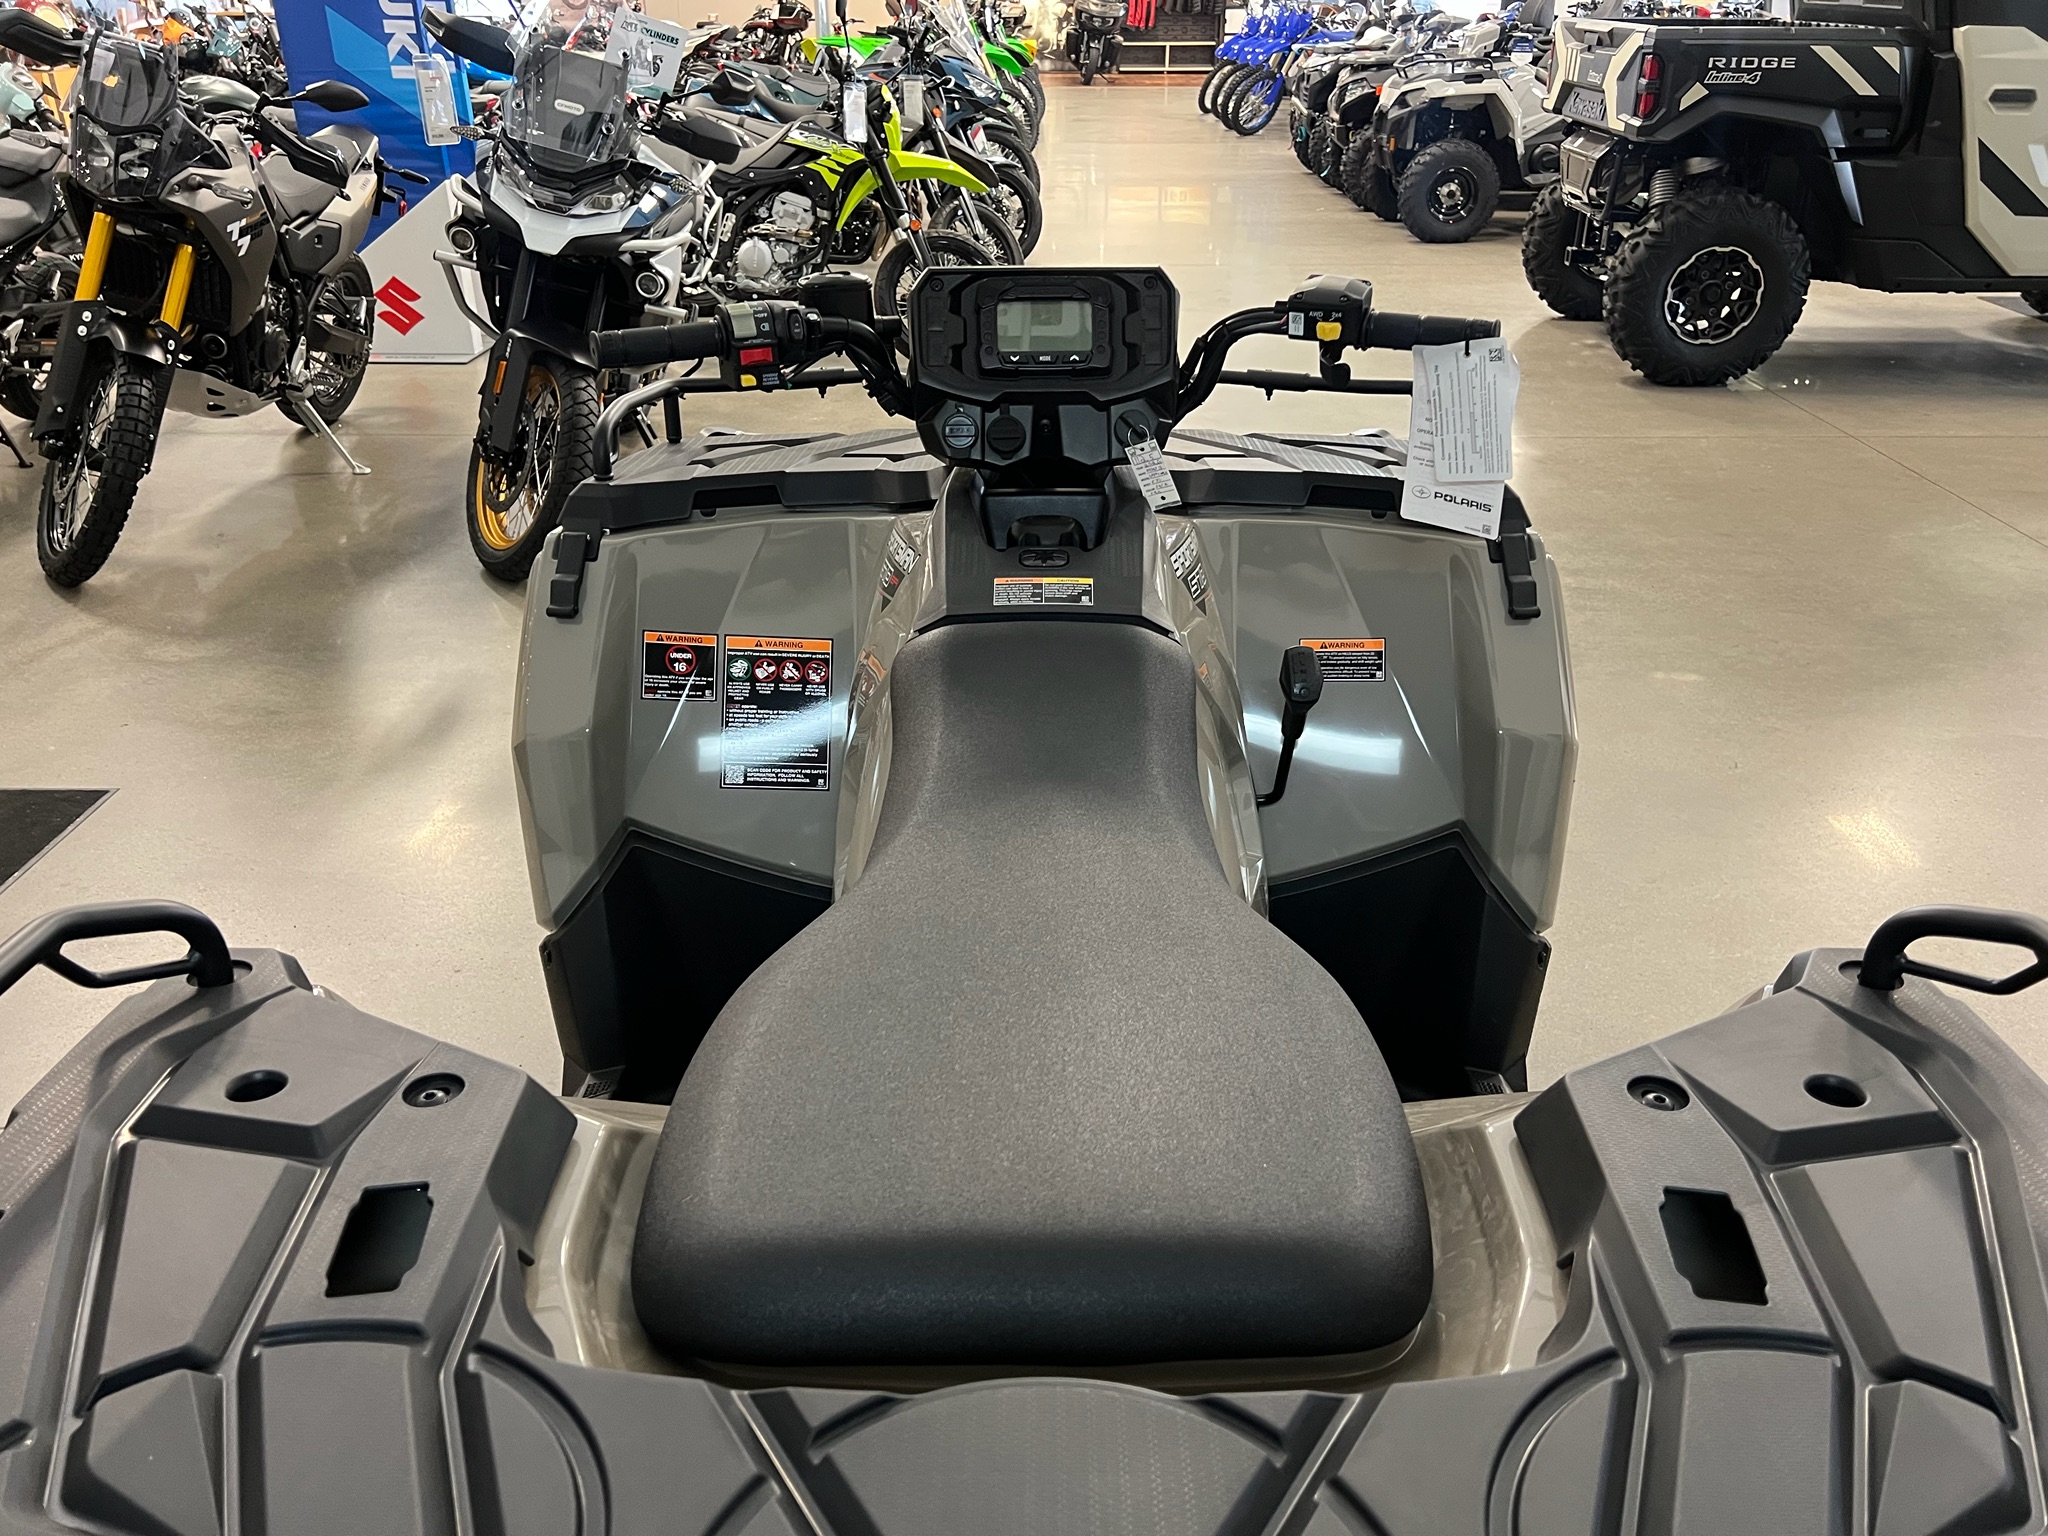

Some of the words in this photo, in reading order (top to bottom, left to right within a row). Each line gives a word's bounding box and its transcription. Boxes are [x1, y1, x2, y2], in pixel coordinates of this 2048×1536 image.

[640, 27, 680, 46] CYLINDERS
[1707, 56, 1797, 69] RIDGE
[1568, 91, 1607, 122] Kawasaki
[1434, 491, 1492, 513] POLARIS
[665, 635, 703, 644] WARNING
[765, 640, 804, 649] WARNING
[673, 662, 687, 672] 16
